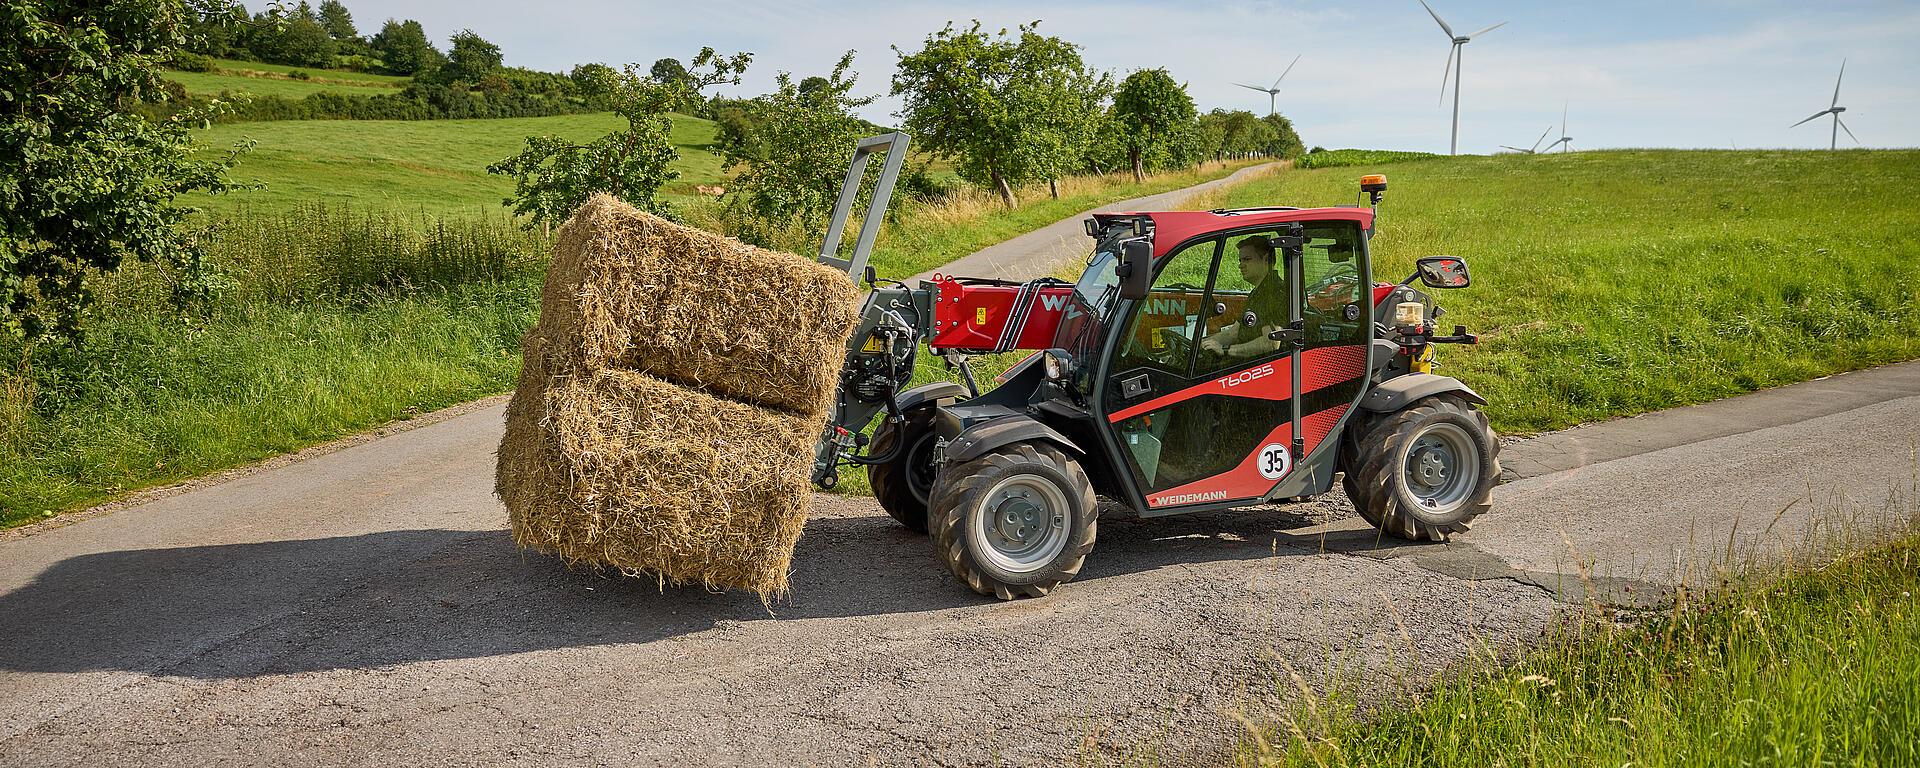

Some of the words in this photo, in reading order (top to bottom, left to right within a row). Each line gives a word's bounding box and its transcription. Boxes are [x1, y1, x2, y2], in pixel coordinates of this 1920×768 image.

[1217, 365, 1274, 389] T6025
[1264, 449, 1283, 473] 35
[1155, 490, 1227, 505] WEIDEMANN
